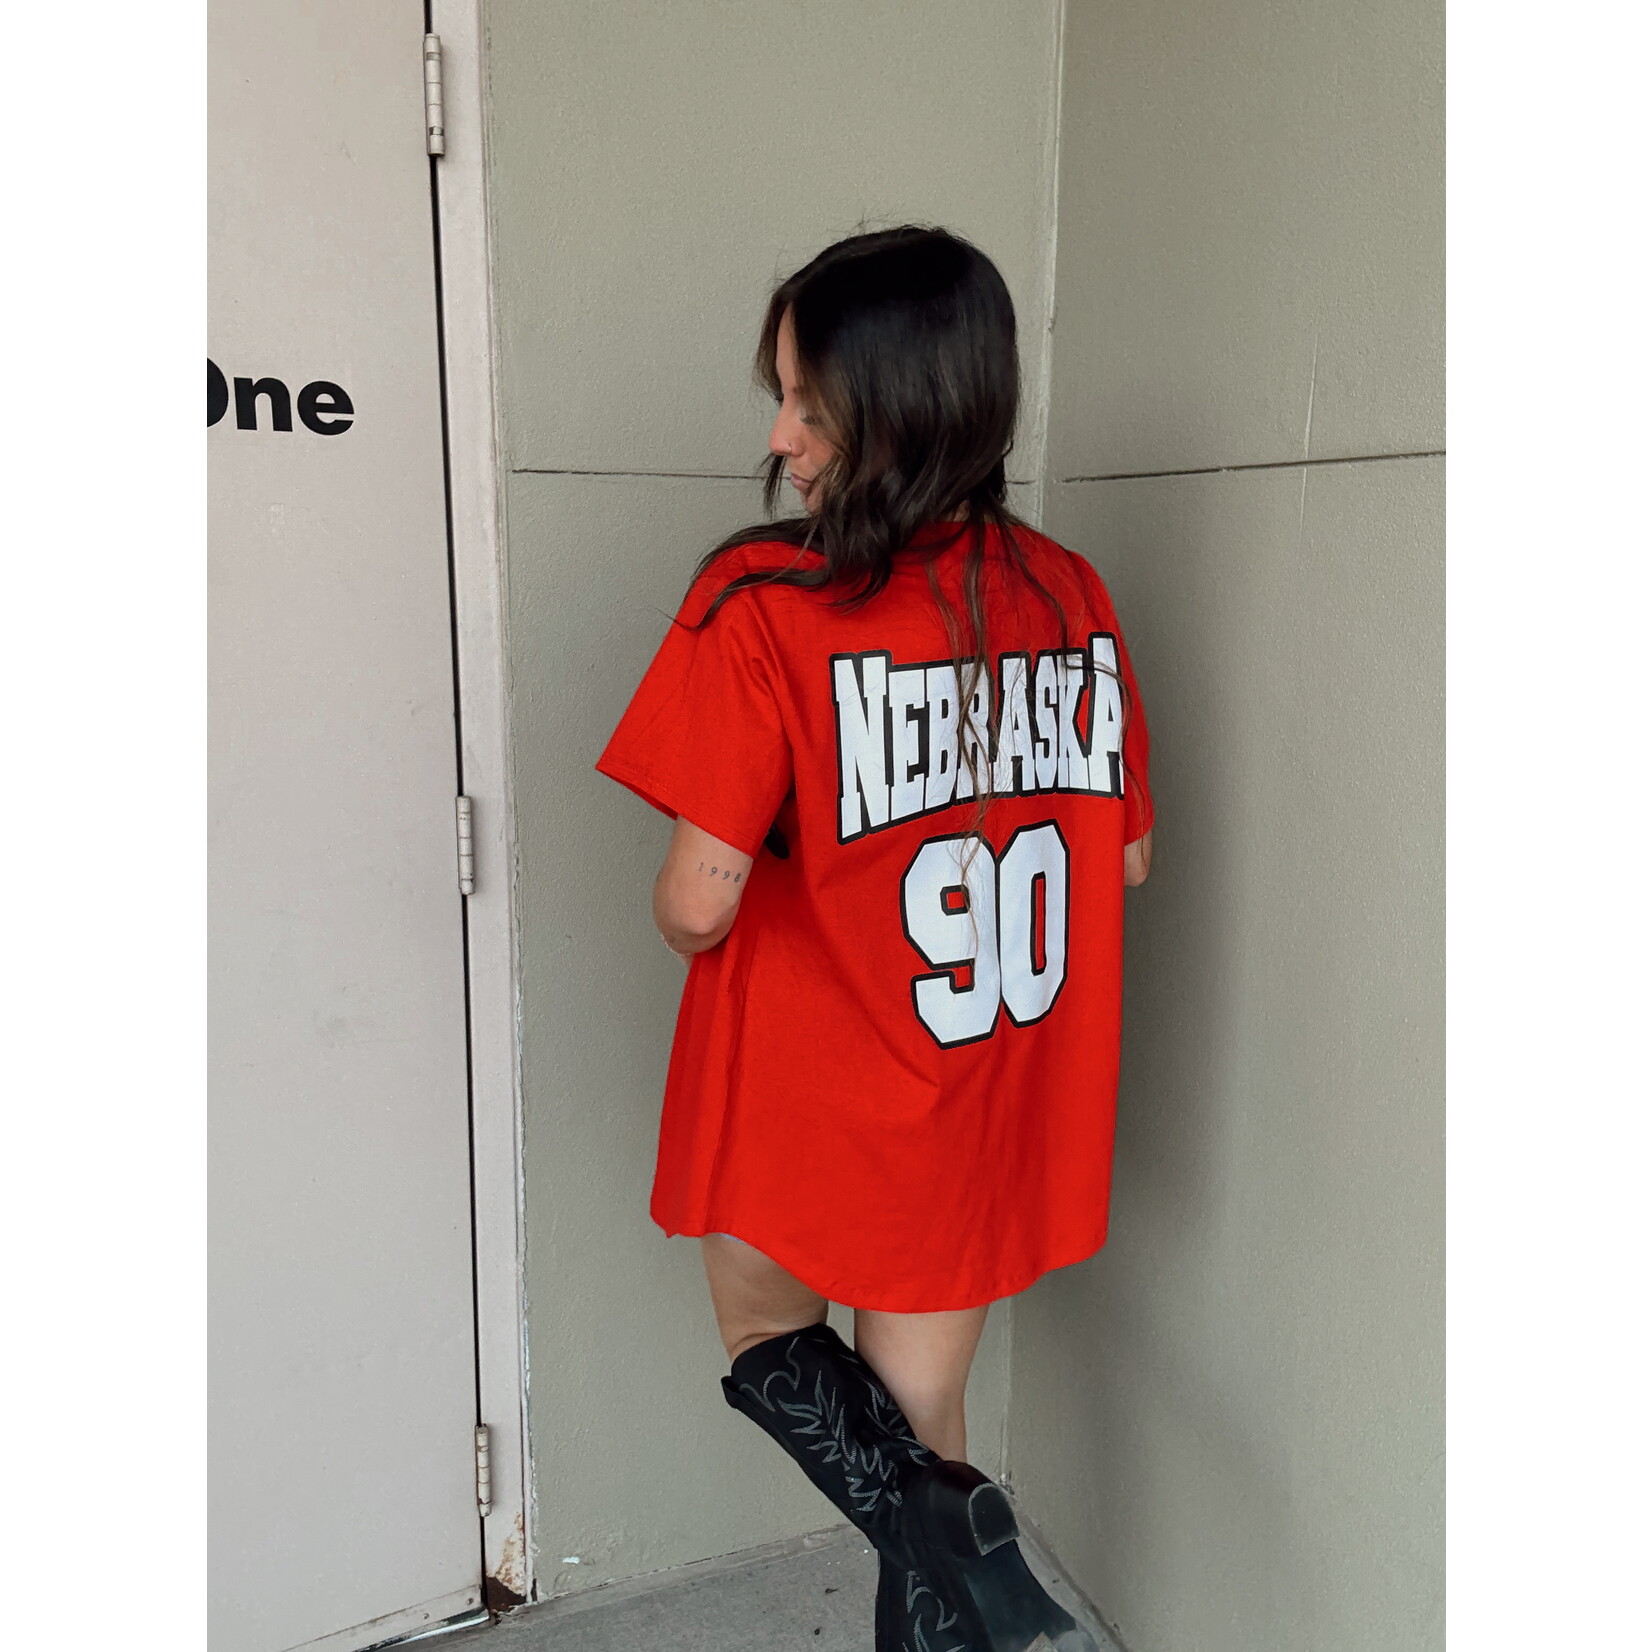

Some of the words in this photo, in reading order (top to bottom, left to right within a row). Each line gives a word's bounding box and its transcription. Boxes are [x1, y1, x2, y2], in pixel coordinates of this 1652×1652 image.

[830, 632, 1124, 844] NEBRASKA
[698, 862, 741, 883] 1998
[901, 818, 1070, 1049] 90
